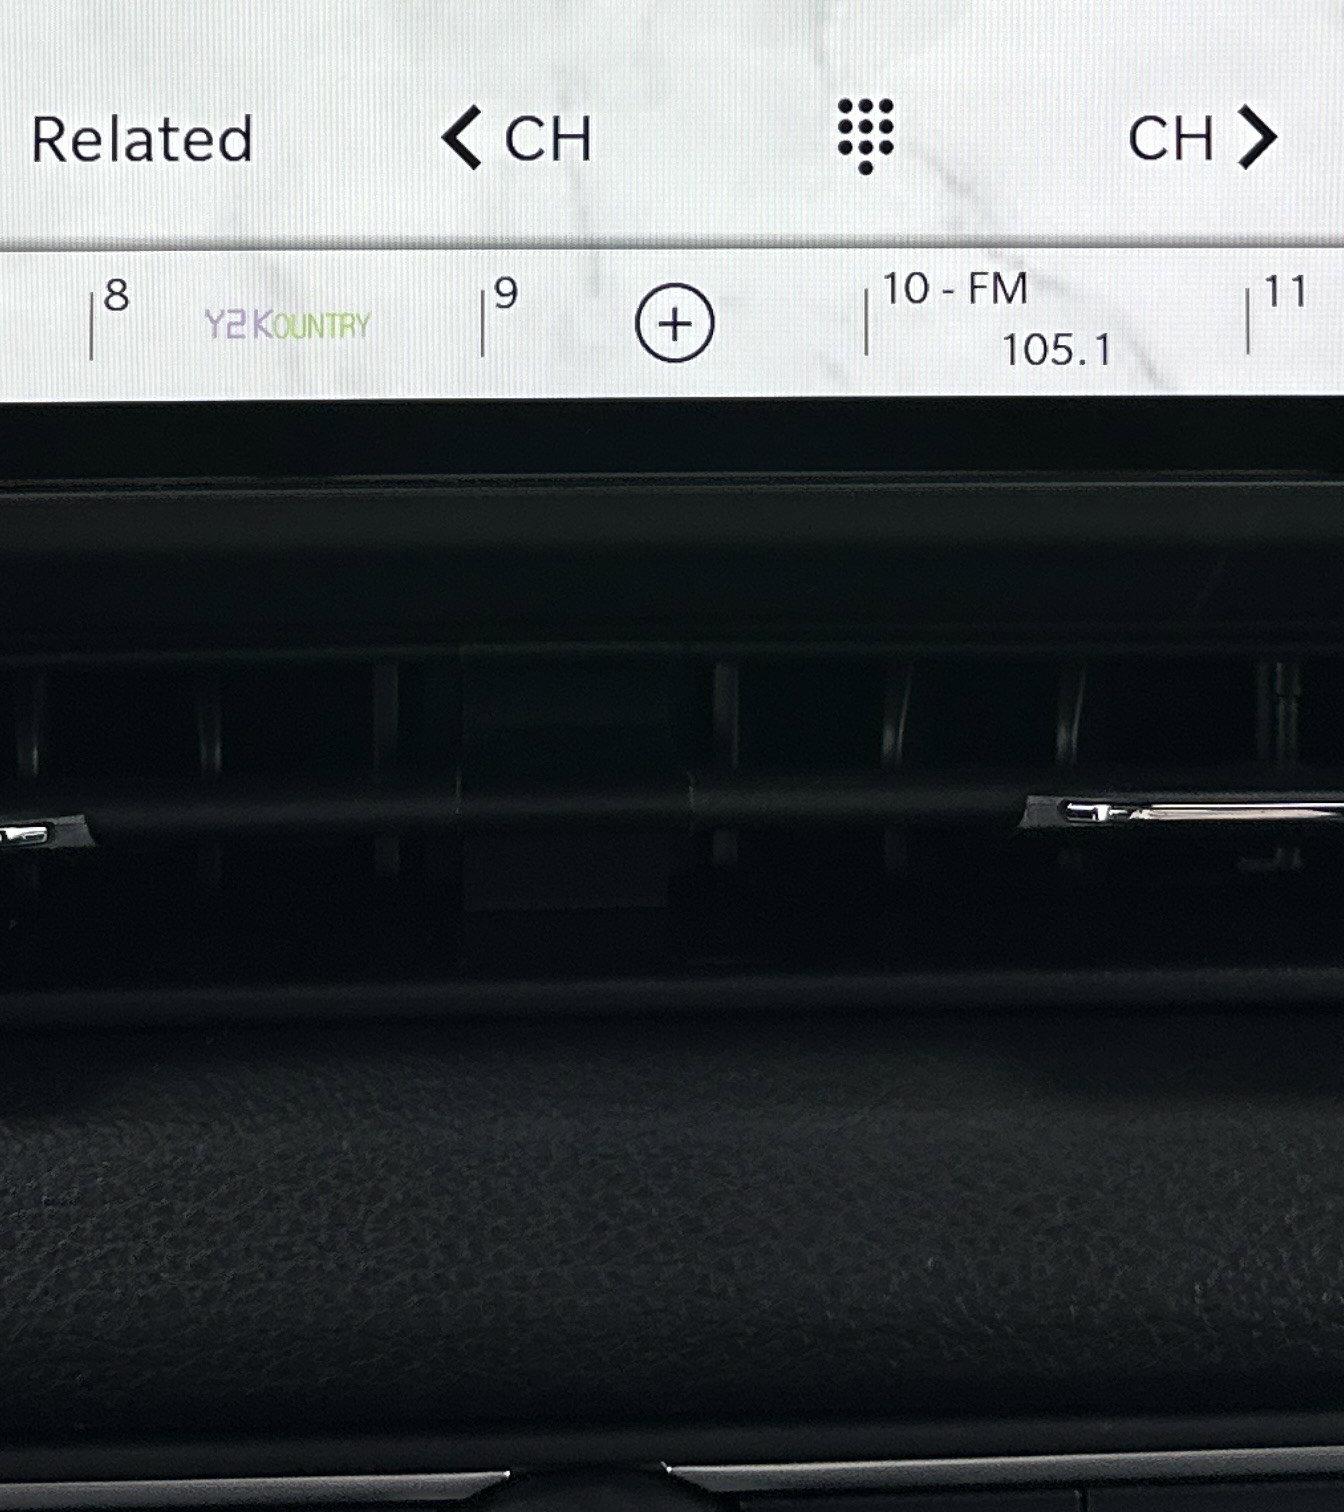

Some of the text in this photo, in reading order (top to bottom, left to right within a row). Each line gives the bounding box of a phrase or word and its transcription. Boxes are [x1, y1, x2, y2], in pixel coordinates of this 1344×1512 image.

[34, 114, 251, 162] Related
[506, 116, 589, 161] CH
[1130, 115, 1212, 160] CH
[104, 278, 129, 311] 8
[495, 276, 517, 309] 9
[885, 272, 929, 304] 10
[970, 272, 1026, 304] FM
[1266, 275, 1303, 307] 11
[1004, 333, 1107, 365] 105.1
